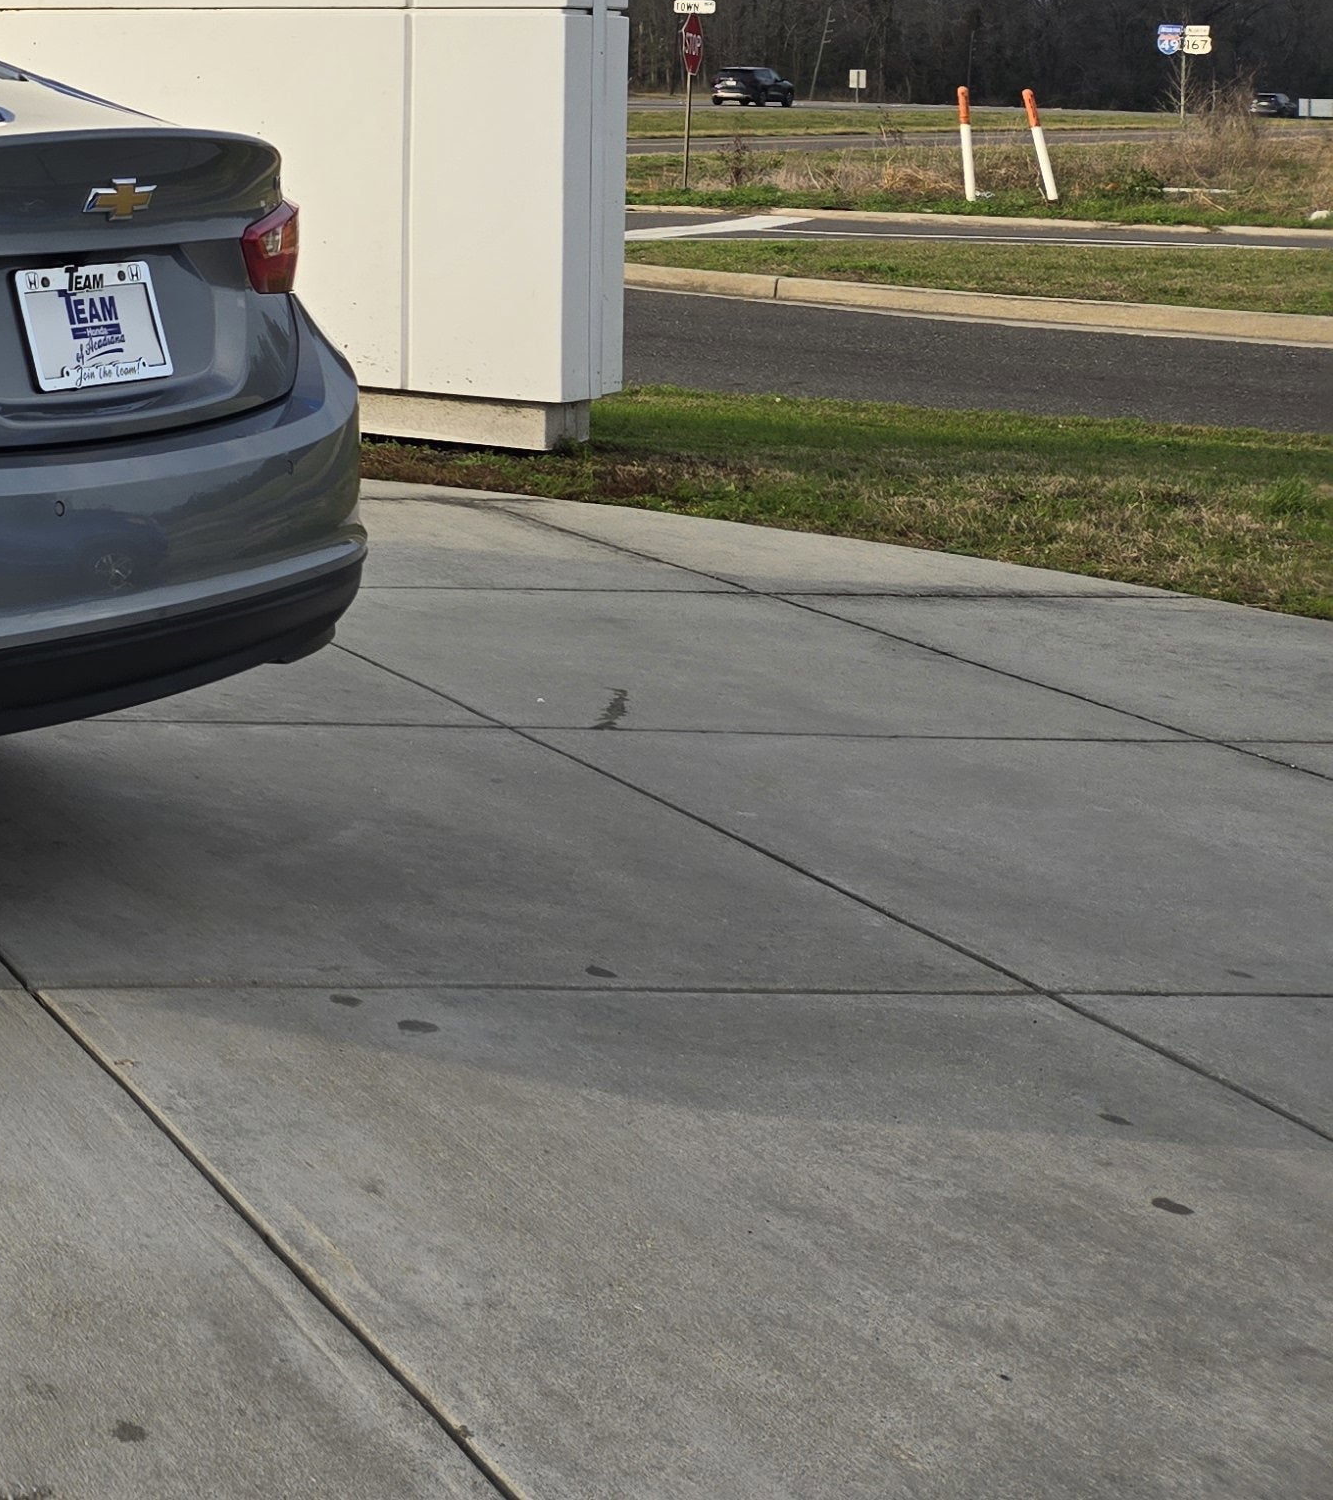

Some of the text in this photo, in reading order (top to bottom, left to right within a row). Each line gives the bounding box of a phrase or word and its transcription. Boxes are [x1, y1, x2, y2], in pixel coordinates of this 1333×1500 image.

[686, 32, 702, 55] STOP
[1160, 40, 1179, 50] 49
[1186, 39, 1208, 50] 167
[65, 266, 104, 292] TEAM
[58, 289, 119, 325] TEAM
[75, 366, 95, 387] Join
